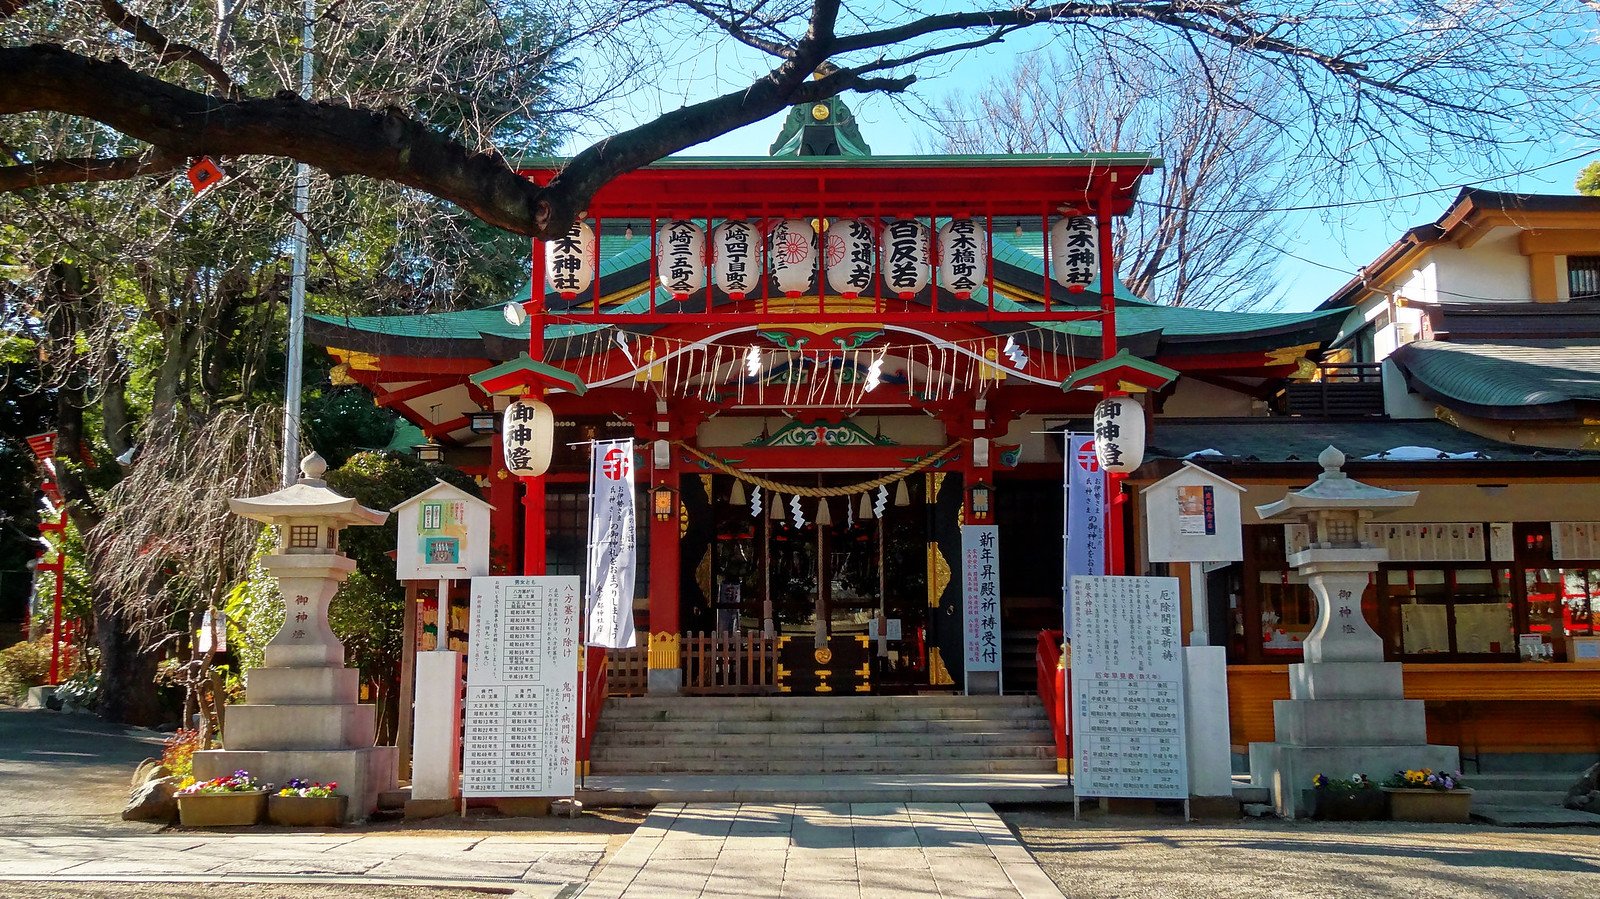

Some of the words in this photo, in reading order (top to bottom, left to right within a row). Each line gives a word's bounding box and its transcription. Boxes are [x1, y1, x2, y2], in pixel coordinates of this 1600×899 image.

[724, 220, 750, 291] 大崎四丁目町会
[948, 220, 977, 290] 居木橋町会
[1066, 218, 1095, 285] 居木神社
[616, 486, 624, 522] お伊勢さま
[563, 584, 574, 658] 八方塞がり除け
